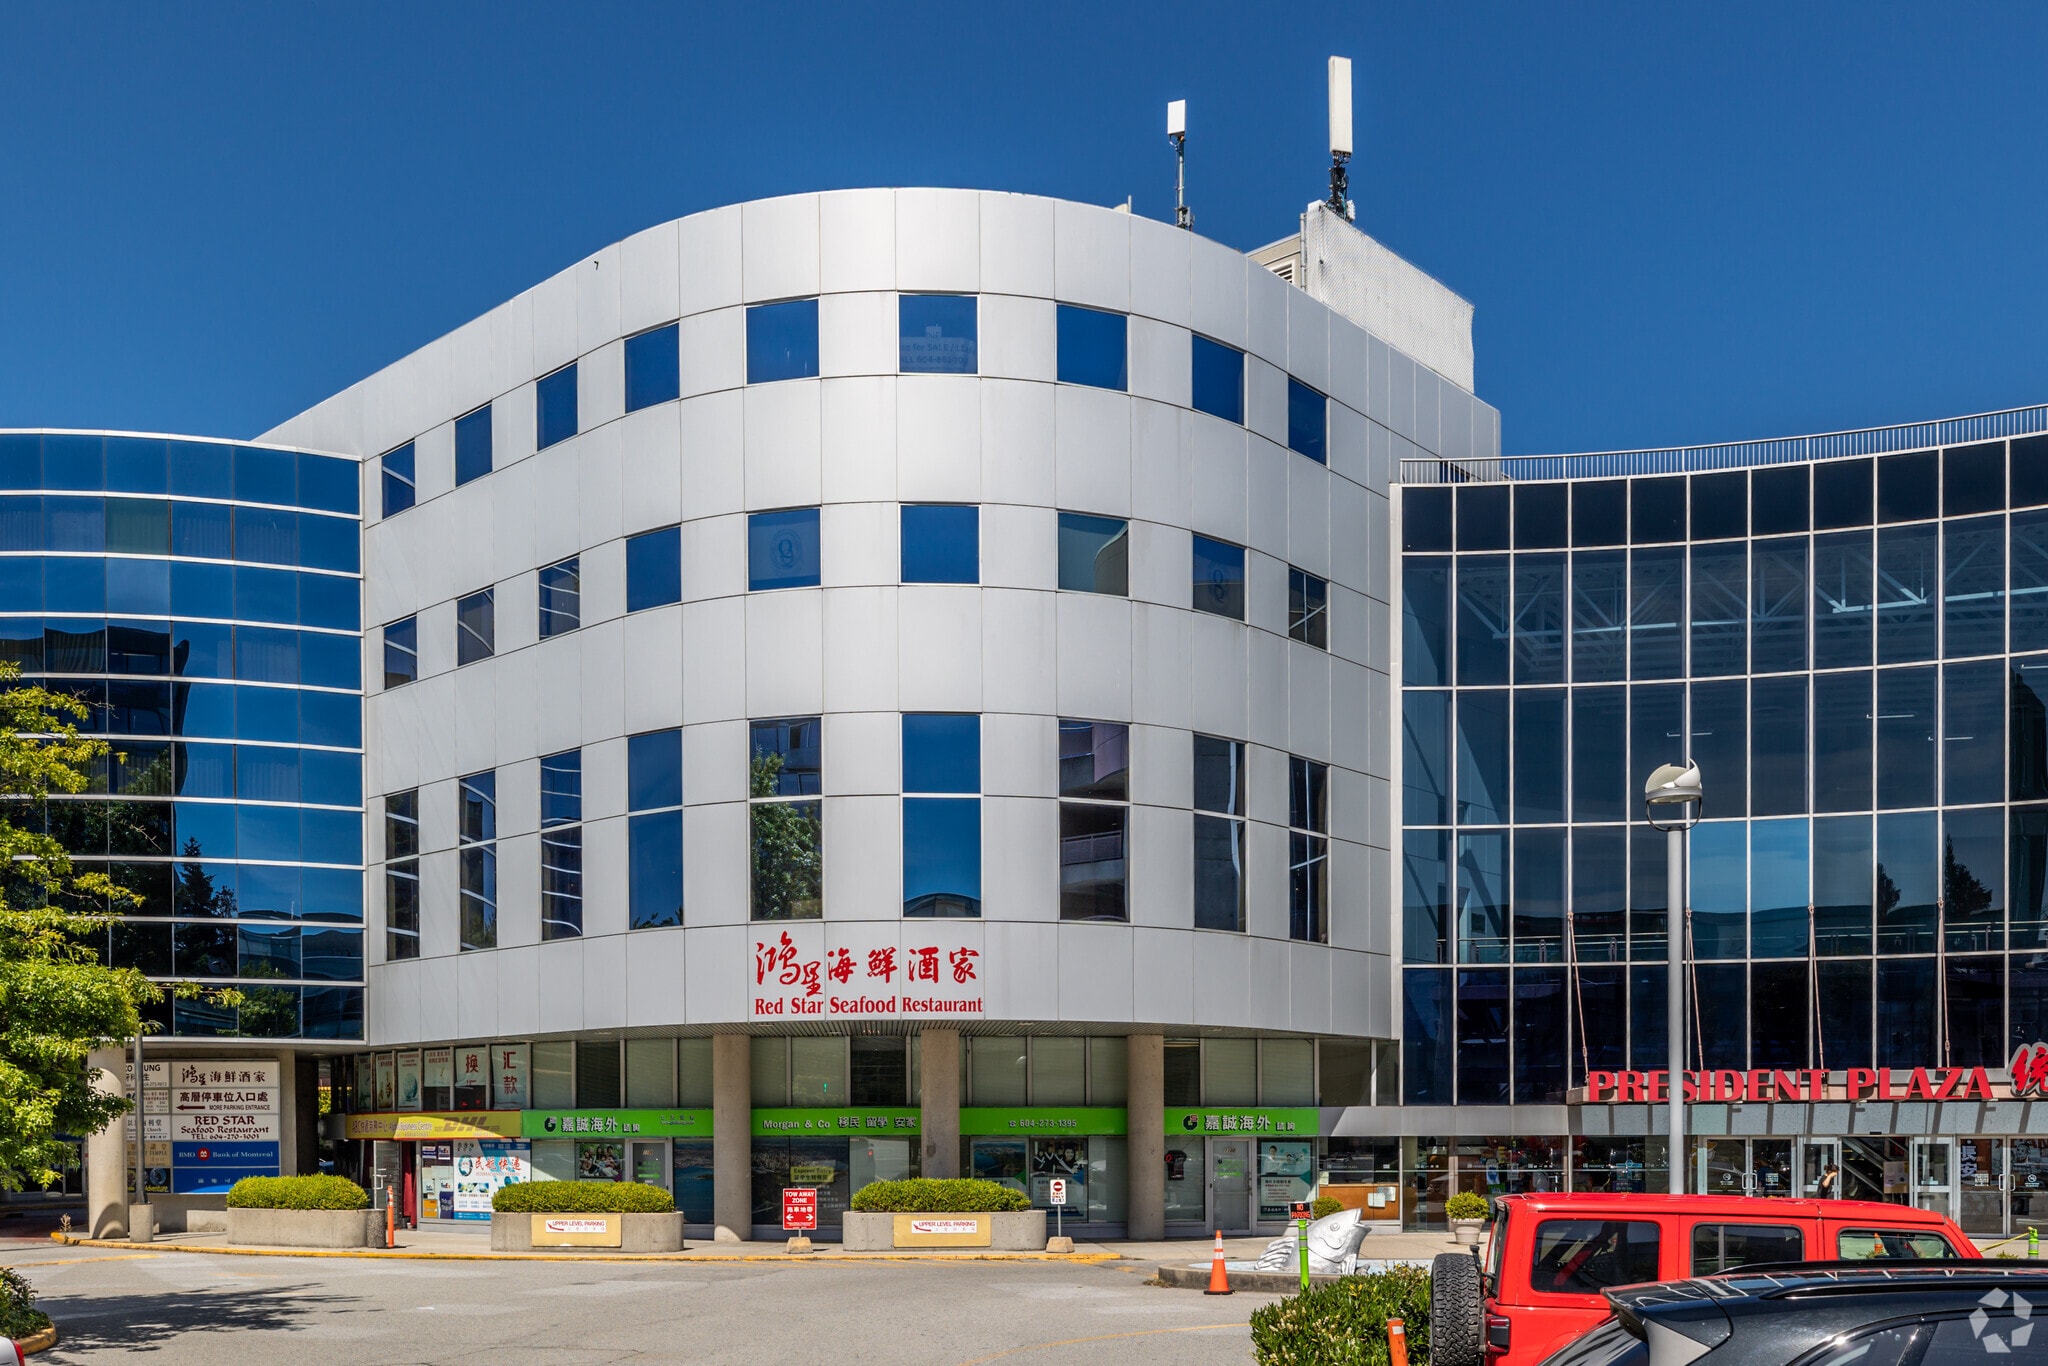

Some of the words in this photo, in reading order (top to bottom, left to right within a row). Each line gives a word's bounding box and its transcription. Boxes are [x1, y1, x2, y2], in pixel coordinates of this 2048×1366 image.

[755, 997, 784, 1015] Red
[790, 997, 824, 1014] Star
[829, 995, 897, 1014] Seafood
[902, 996, 984, 1012] Restaurant
[503, 1051, 518, 1095] 汇款
[1588, 1068, 1831, 1103] PRESIDENT
[1847, 1066, 1994, 1101] PLAZA
[179, 1091, 269, 1103] 高層停車位入口處
[194, 1115, 220, 1126] RED
[223, 1115, 256, 1126] STAR
[442, 1116, 491, 1132] DHL
[561, 1116, 619, 1133] 嘉誠海外
[763, 1119, 800, 1130] Morgan
[804, 1120, 814, 1129] &
[817, 1119, 831, 1129] Co
[838, 1116, 860, 1129] 移民
[866, 1116, 889, 1129] 留學
[1205, 1114, 1270, 1132] 嘉誠海外
[180, 1125, 215, 1134] Seafood
[217, 1125, 270, 1134] Restaurant
[1296, 1203, 1304, 1211] NO
[1291, 1211, 1311, 1219] PARKING
